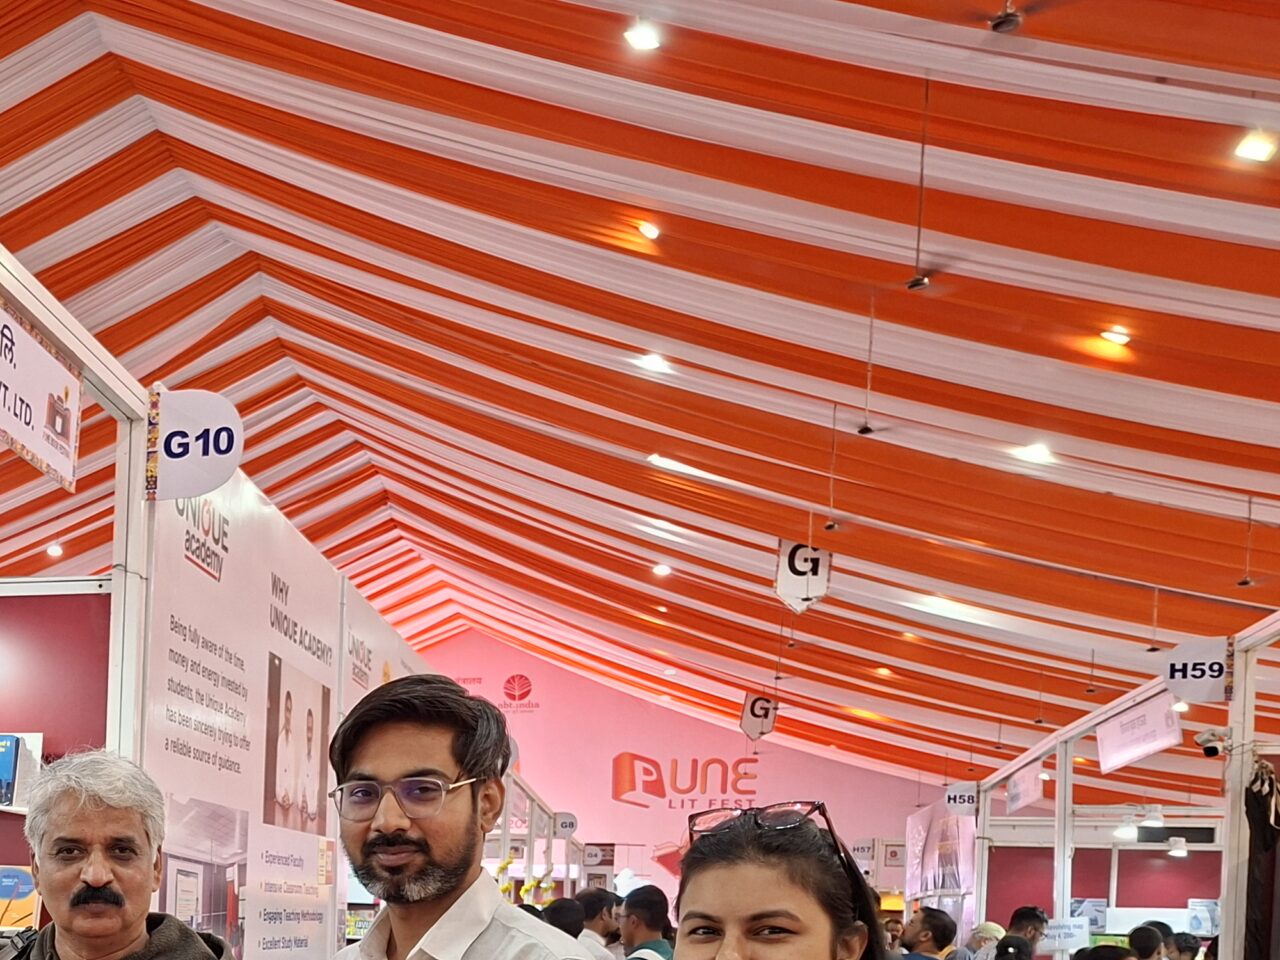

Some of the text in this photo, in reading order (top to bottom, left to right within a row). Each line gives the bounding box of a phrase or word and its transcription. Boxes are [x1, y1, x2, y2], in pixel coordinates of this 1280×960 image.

[13, 393, 35, 431] LTD.
[163, 426, 234, 459] G10
[175, 497, 230, 554] UNIQUE
[184, 529, 224, 583] academy
[787, 543, 821, 576] G
[270, 571, 290, 606] WHY
[170, 614, 187, 642] Being
[188, 624, 200, 649] fully
[201, 636, 217, 656] aware
[218, 644, 224, 658] of
[224, 647, 233, 664] the
[270, 603, 333, 667] UNIQUE ACADEMY?
[168, 648, 189, 672] money
[190, 659, 201, 675] and
[202, 665, 220, 688] energy
[221, 672, 241, 696] invested
[1169, 661, 1224, 679] H59
[195, 688, 204, 706] the
[205, 692, 223, 714] Unique
[224, 702, 247, 727] Academy
[749, 696, 771, 720] G
[166, 704, 176, 723] has
[178, 709, 192, 729] been
[218, 727, 233, 748] trying
[170, 737, 191, 758] reliable
[193, 747, 211, 764] source
[212, 751, 218, 766] of
[668, 799, 756, 809] LIT FEST
[947, 794, 975, 805] H58
[560, 821, 574, 829] G8
[263, 908, 282, 924] Engaging
[283, 909, 300, 924] Teaching
[262, 936, 308, 951] Excellent Study Material
